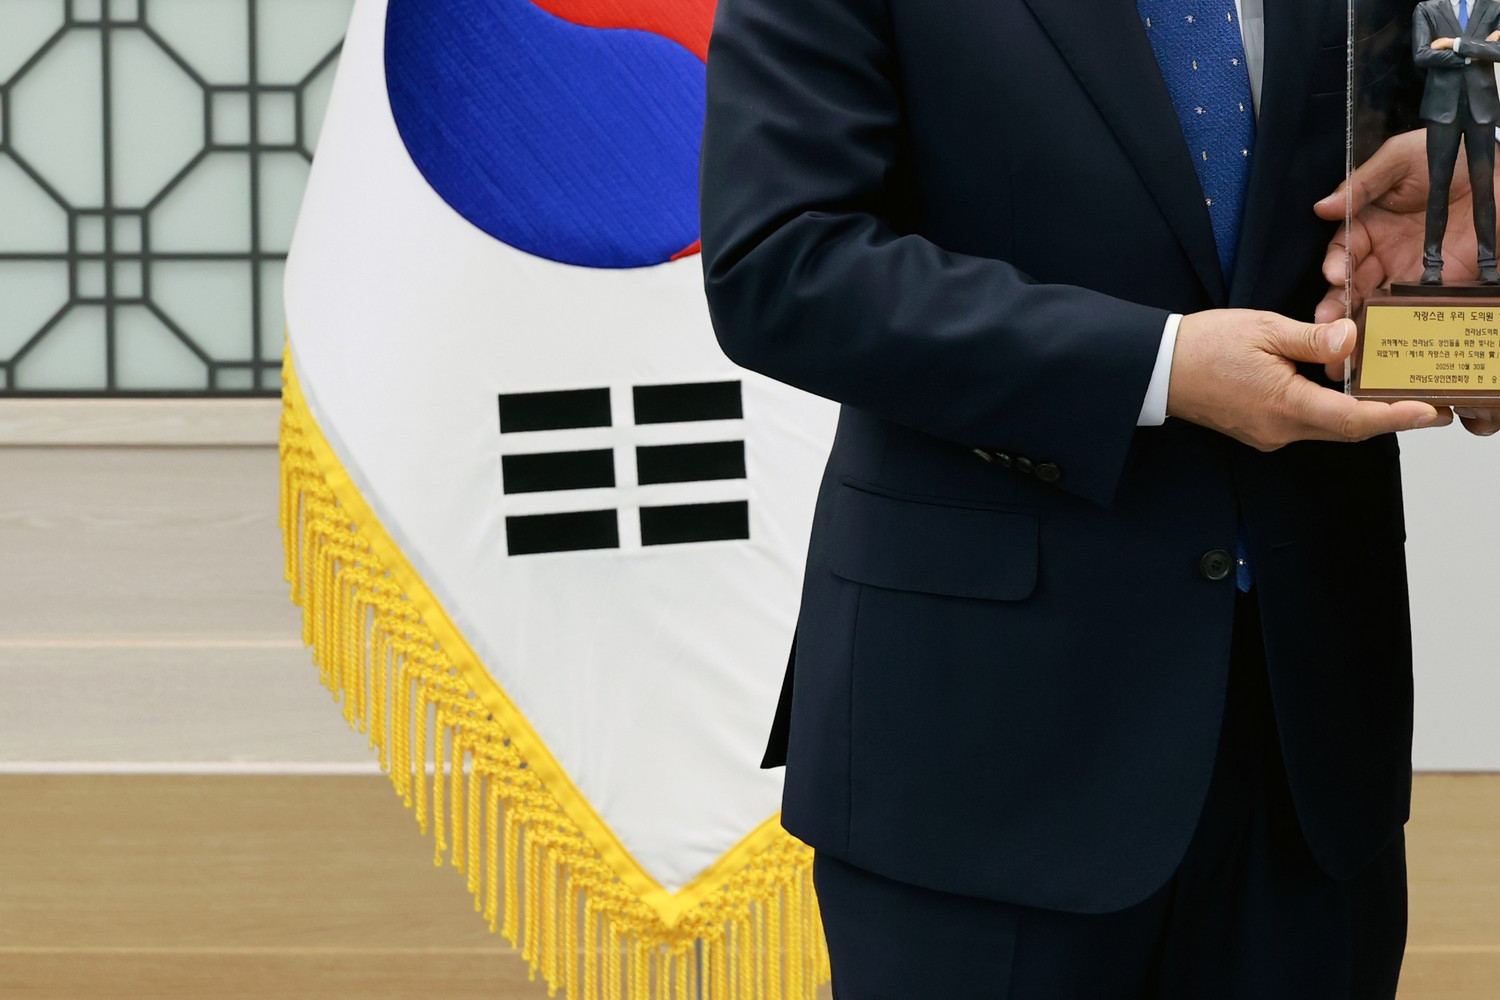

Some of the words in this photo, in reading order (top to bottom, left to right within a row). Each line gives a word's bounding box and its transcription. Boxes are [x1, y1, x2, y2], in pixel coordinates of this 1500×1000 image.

[1413, 311, 1445, 322] 자랑스런
[1450, 311, 1465, 322] 우리
[1470, 311, 1494, 322] 도의원
[1464, 328, 1499, 337] 전라남도의회
[1412, 338, 1435, 348] 전라남도
[1464, 339, 1475, 348] 위한
[1427, 350, 1450, 359] 자랑스런
[1454, 350, 1465, 359] 우리
[1468, 350, 1485, 359] 도의원
[1435, 362, 1455, 371] 2025년
[1458, 362, 1471, 371] 10월
[1473, 362, 1486, 371] 30일
